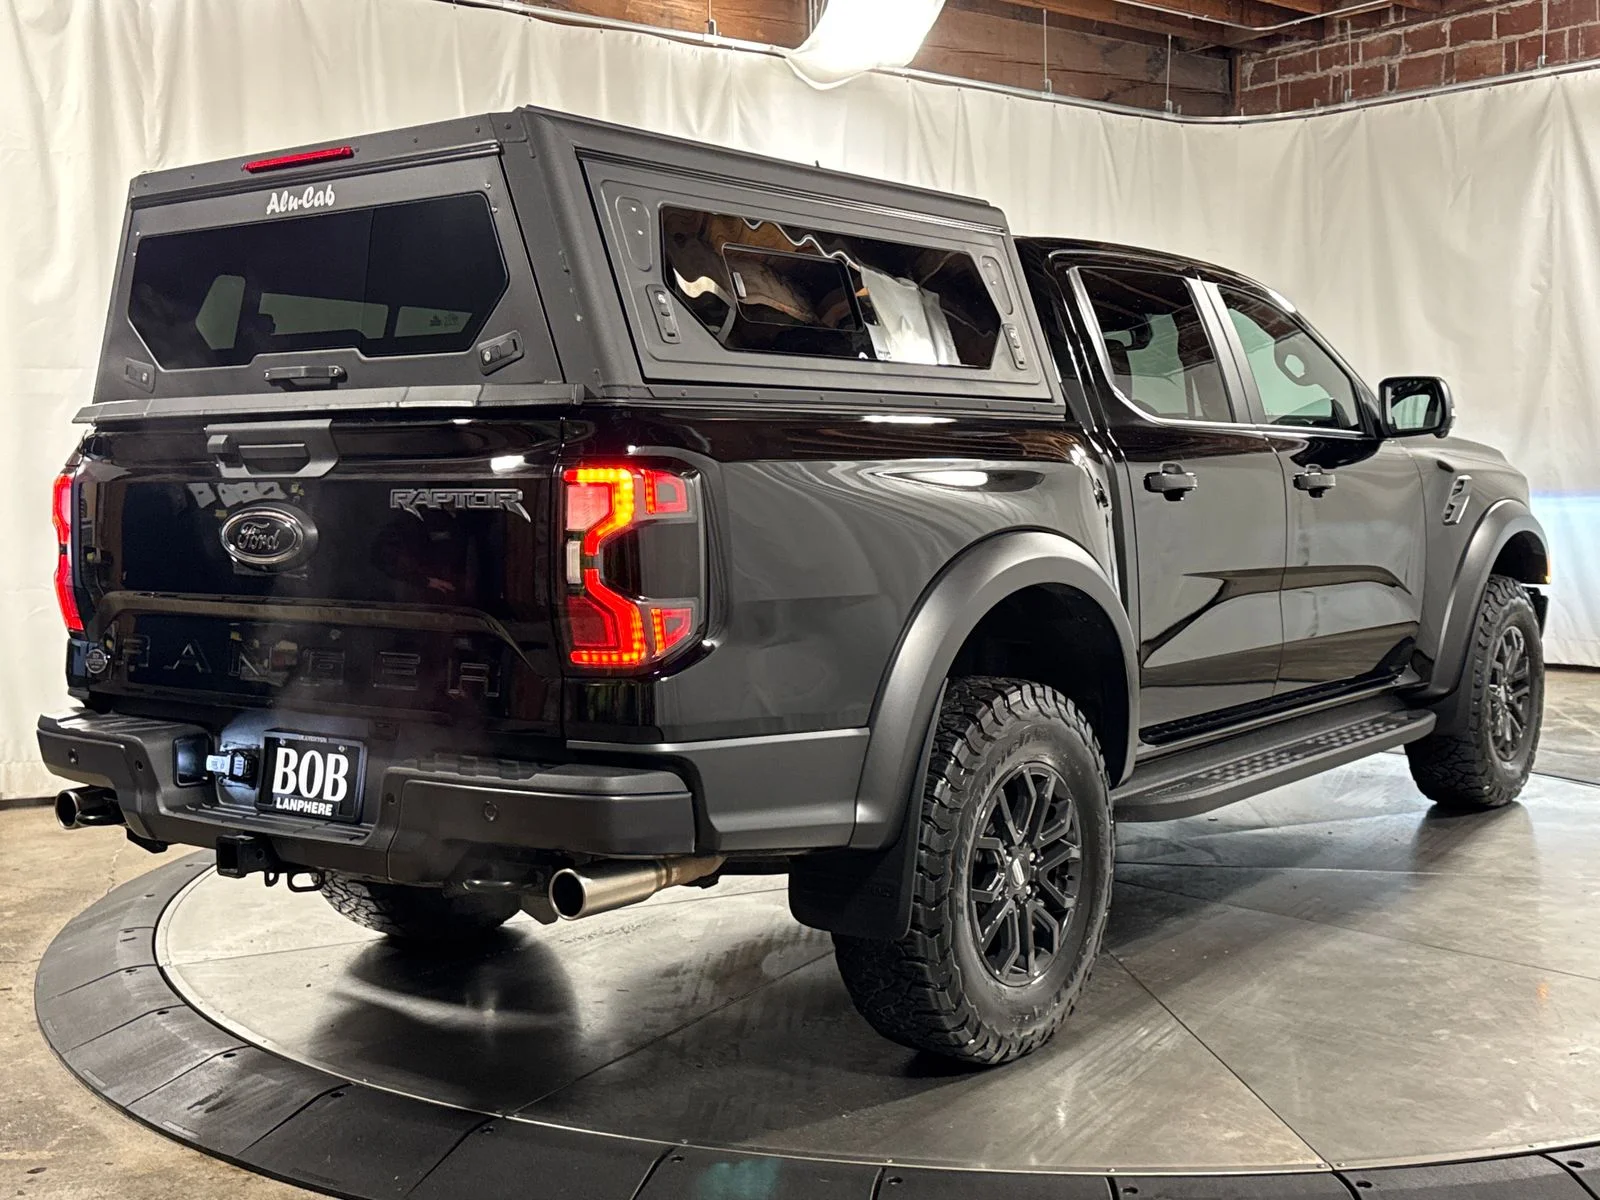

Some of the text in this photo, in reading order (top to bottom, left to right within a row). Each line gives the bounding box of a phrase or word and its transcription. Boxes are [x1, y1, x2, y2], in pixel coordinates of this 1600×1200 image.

[266, 184, 335, 215] Alu-Cab
[390, 488, 532, 523] RAPTOR
[237, 521, 281, 550] Ford
[117, 633, 500, 698] RANGER
[272, 747, 349, 802] BOB
[275, 796, 334, 817] LANPHERE
